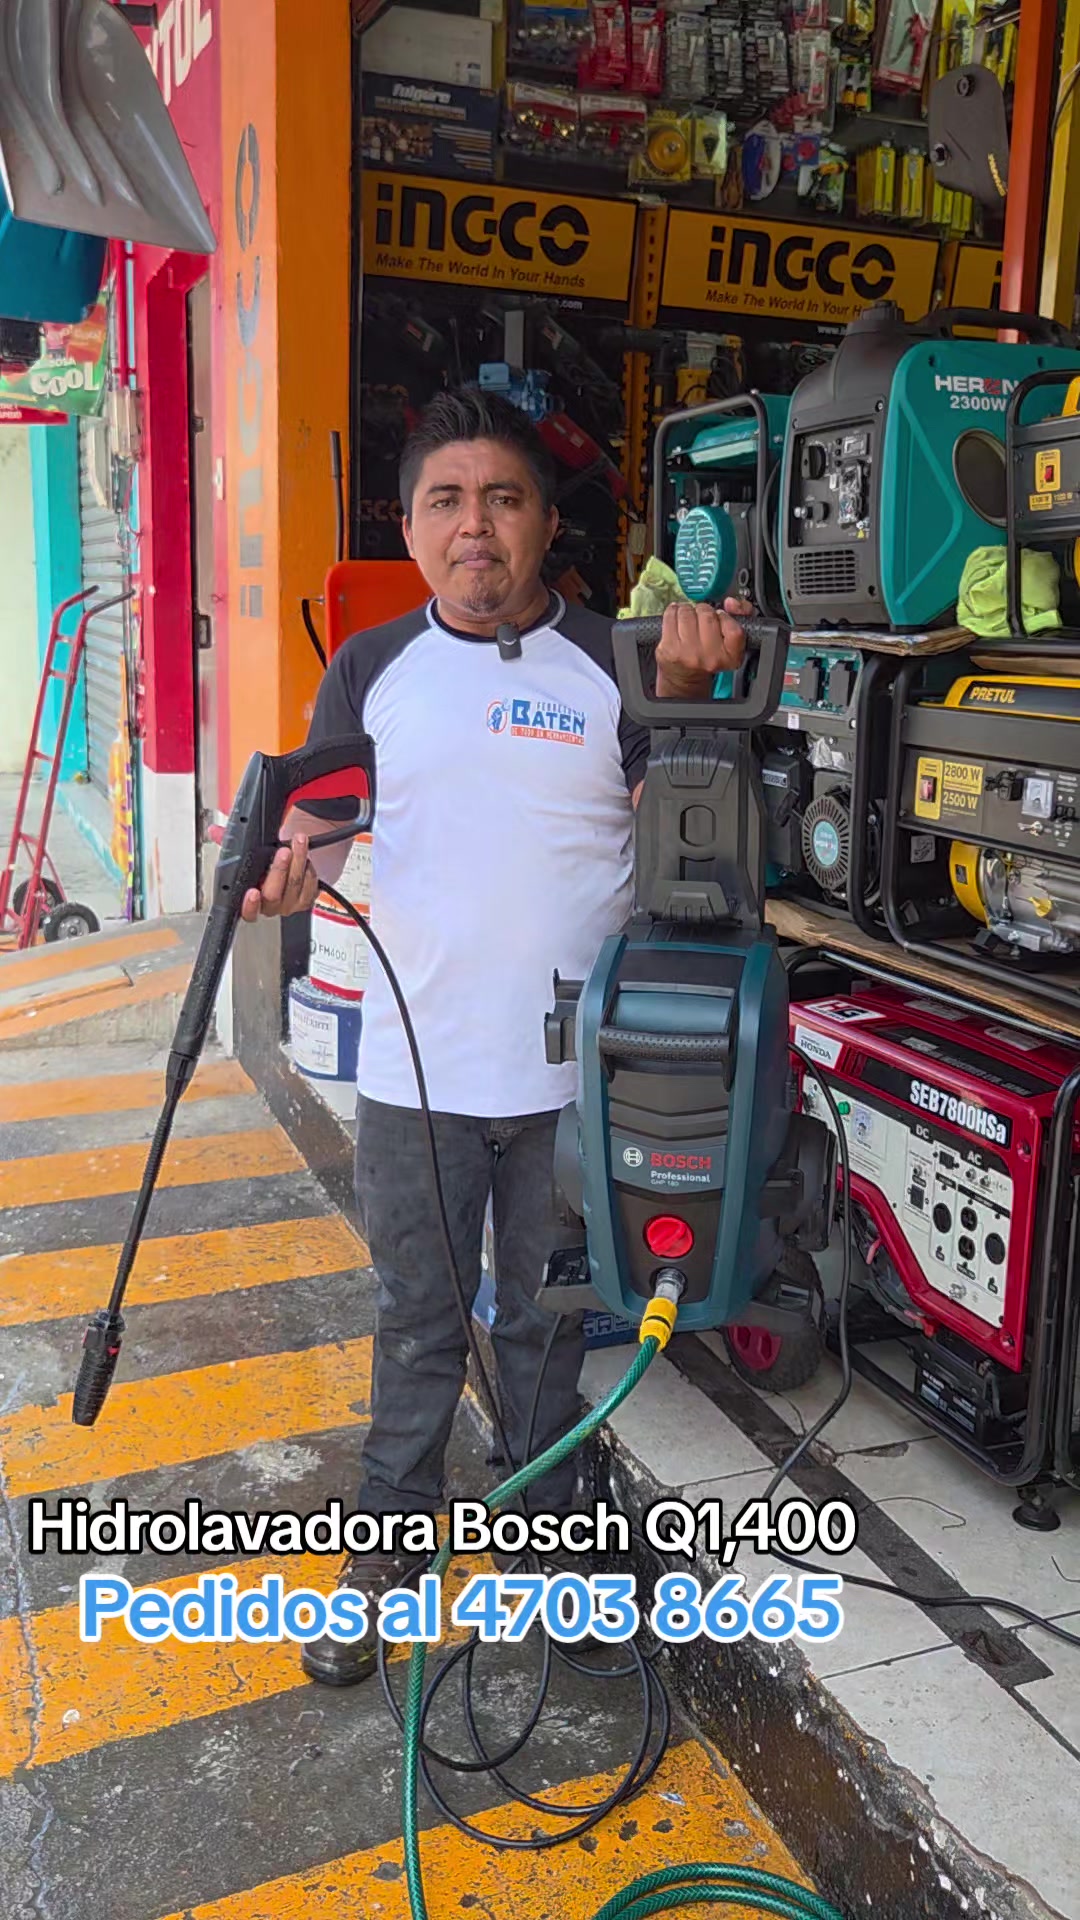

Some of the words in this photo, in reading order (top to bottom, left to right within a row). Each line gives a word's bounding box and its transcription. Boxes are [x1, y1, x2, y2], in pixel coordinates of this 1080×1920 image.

[375, 253, 413, 270] Make
[418, 257, 443, 273] The
[449, 261, 489, 278] World
[493, 266, 505, 280] In
[511, 269, 540, 284] Your
[543, 272, 586, 288] Hands
[706, 289, 738, 304] Make
[743, 293, 765, 308] The
[769, 296, 804, 312] World
[807, 301, 818, 313] In
[822, 301, 849, 316] Your
[950, 395, 1007, 412] 2300W
[970, 686, 1016, 704] PRETUL
[511, 699, 586, 736] BATEN
[944, 764, 968, 780] 2800
[971, 767, 981, 782] W
[943, 792, 966, 809] 2500
[967, 796, 979, 810] W
[800, 1039, 831, 1060] HONDA
[910, 1080, 1007, 1146] SEB7800HSa
[915, 1124, 930, 1140] DC
[650, 1152, 712, 1170] BOSCH
[967, 1151, 983, 1167] AC
[650, 1170, 711, 1183] Professional
